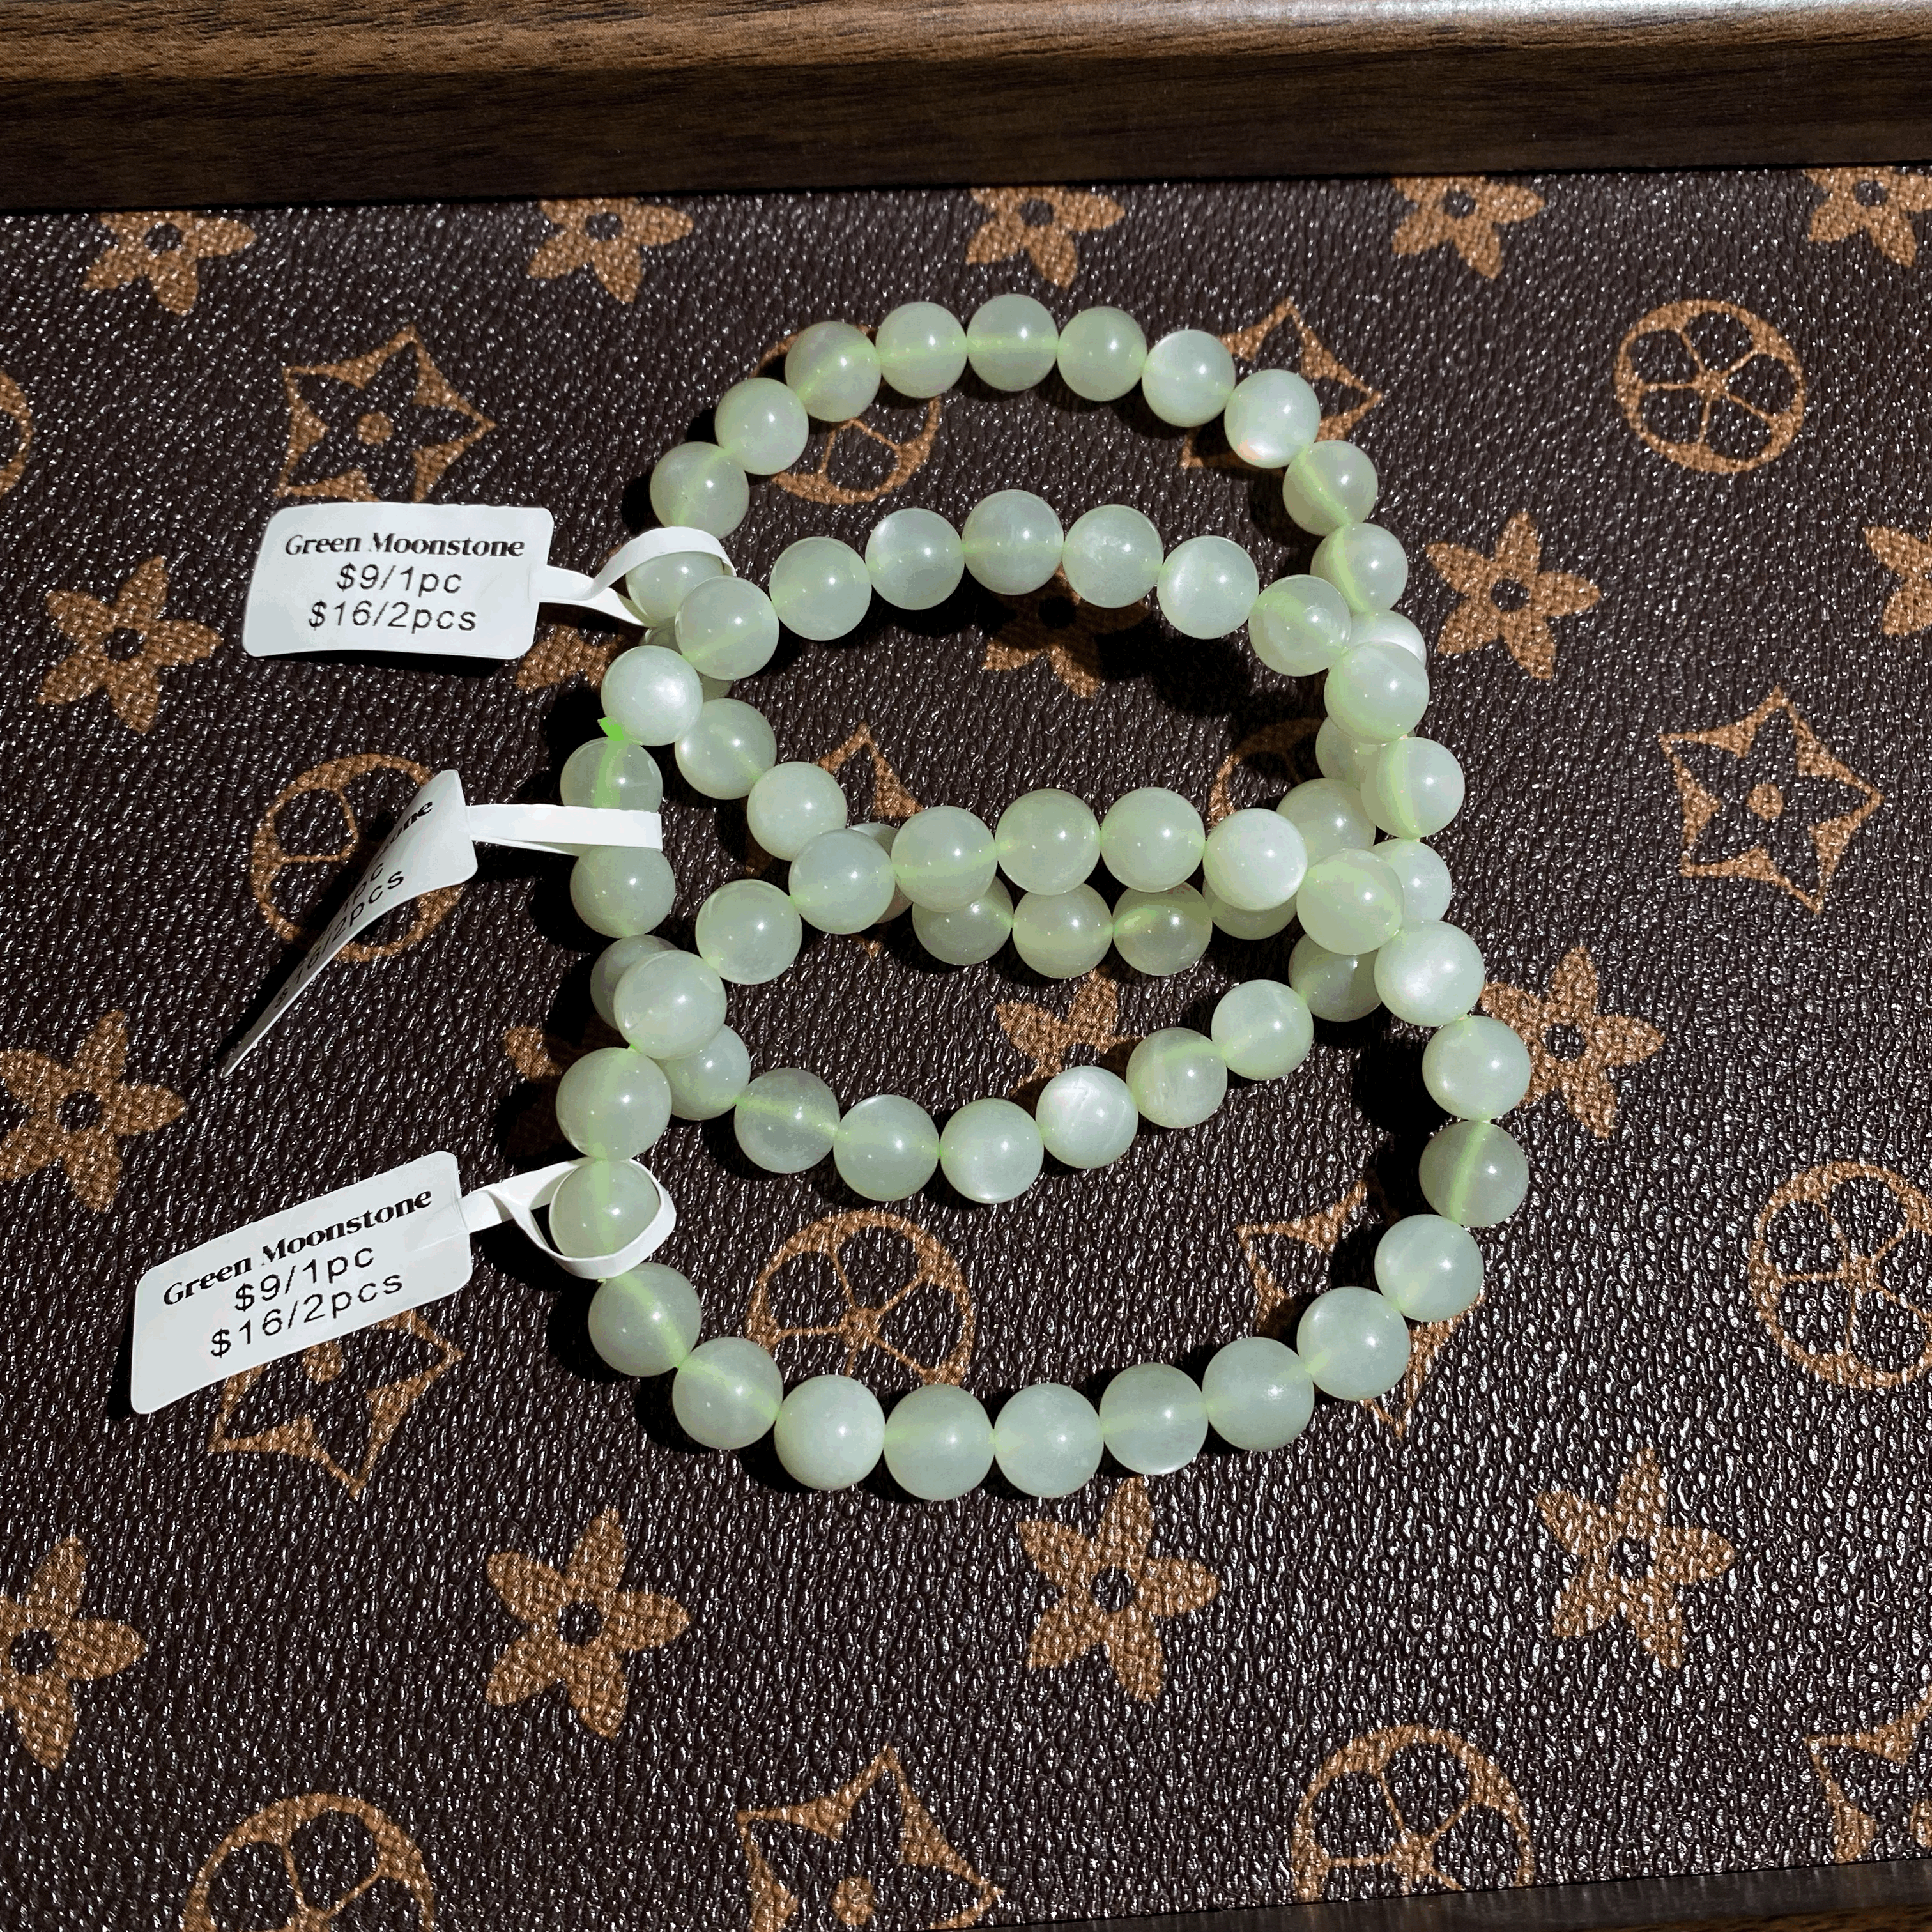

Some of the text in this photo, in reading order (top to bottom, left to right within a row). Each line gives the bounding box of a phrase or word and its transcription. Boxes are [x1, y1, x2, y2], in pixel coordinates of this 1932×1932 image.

[285, 533, 525, 557] Green Moonstone
[337, 563, 462, 597] $9/1pc
[309, 601, 477, 634] $16/2pcs
[164, 1190, 432, 1305] Green Moonstone
[234, 1247, 374, 1312] $9/1pc
[211, 1274, 402, 1358] $16/2pcs
